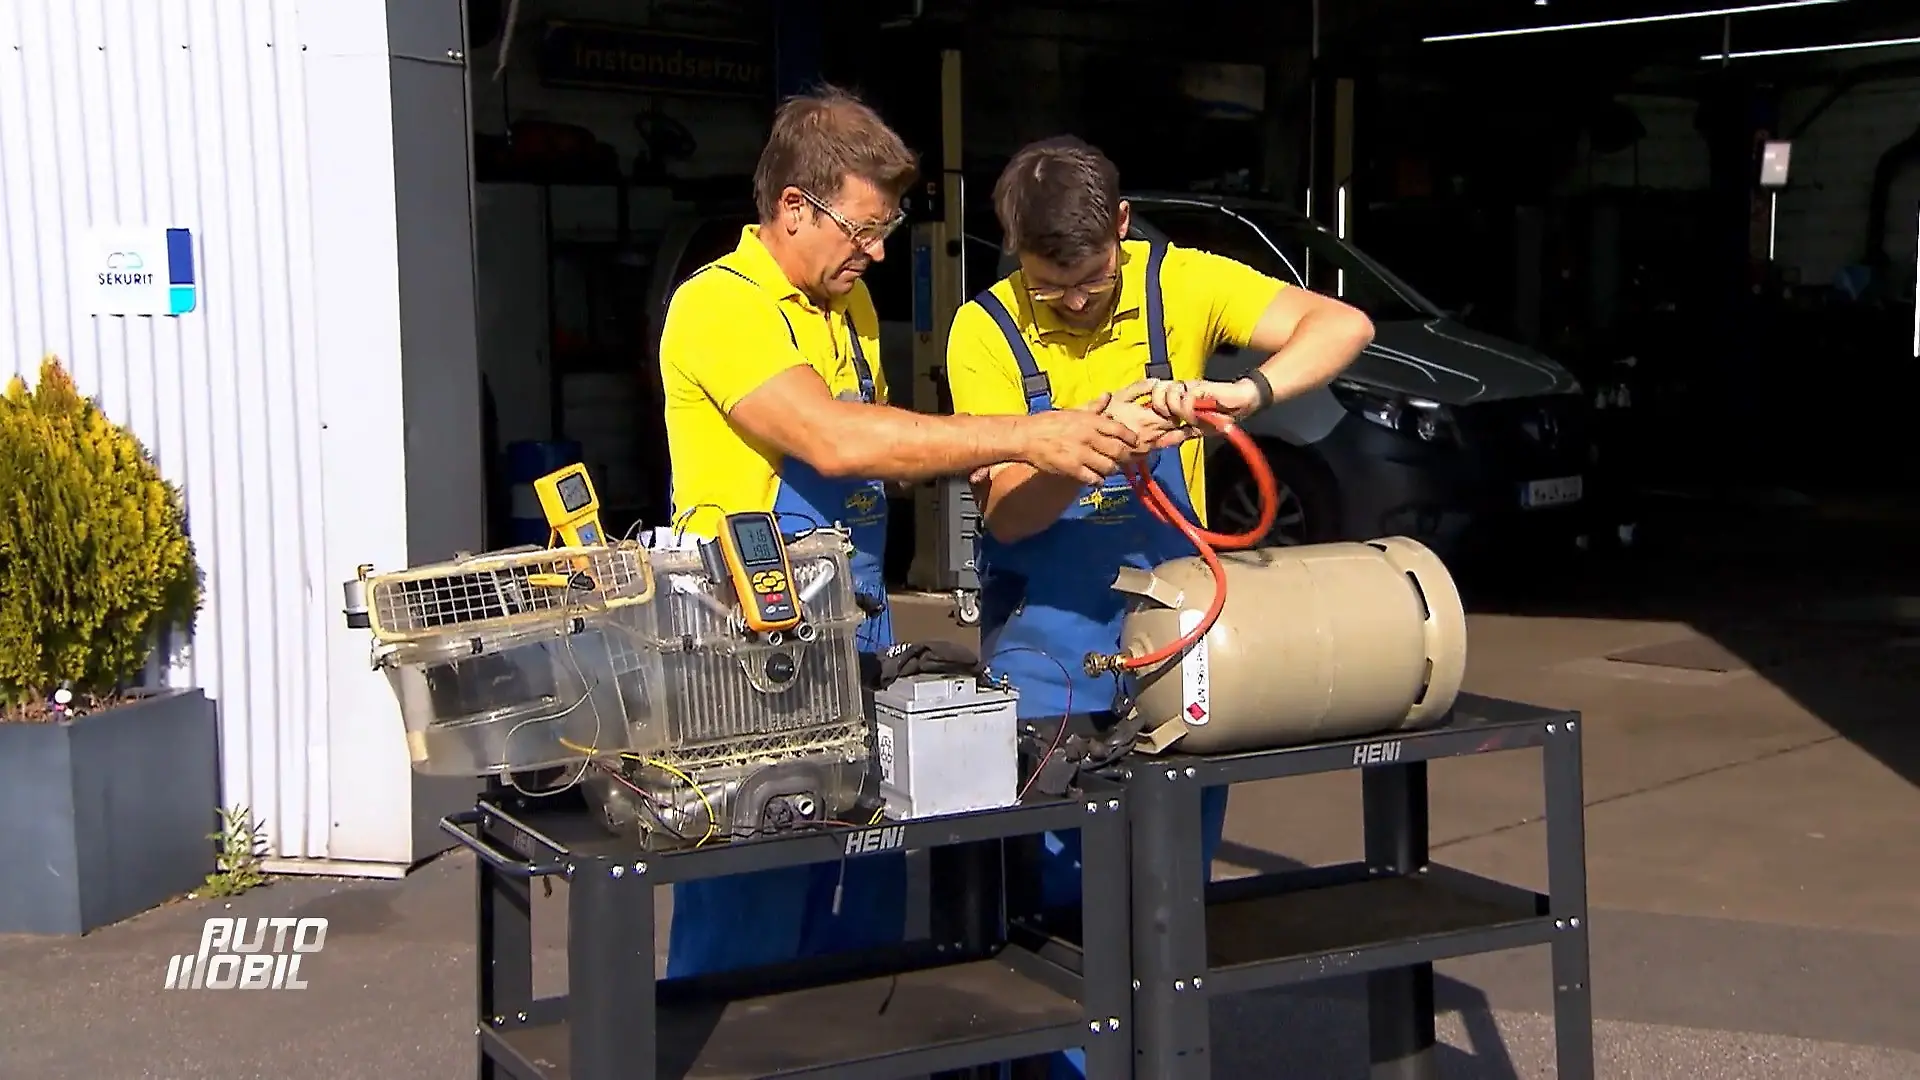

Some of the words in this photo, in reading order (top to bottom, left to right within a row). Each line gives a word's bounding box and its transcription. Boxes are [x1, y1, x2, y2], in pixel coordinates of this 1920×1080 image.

[98, 272, 153, 286] SEKURIT
[1353, 741, 1401, 765] HENI
[845, 825, 905, 855] HENI
